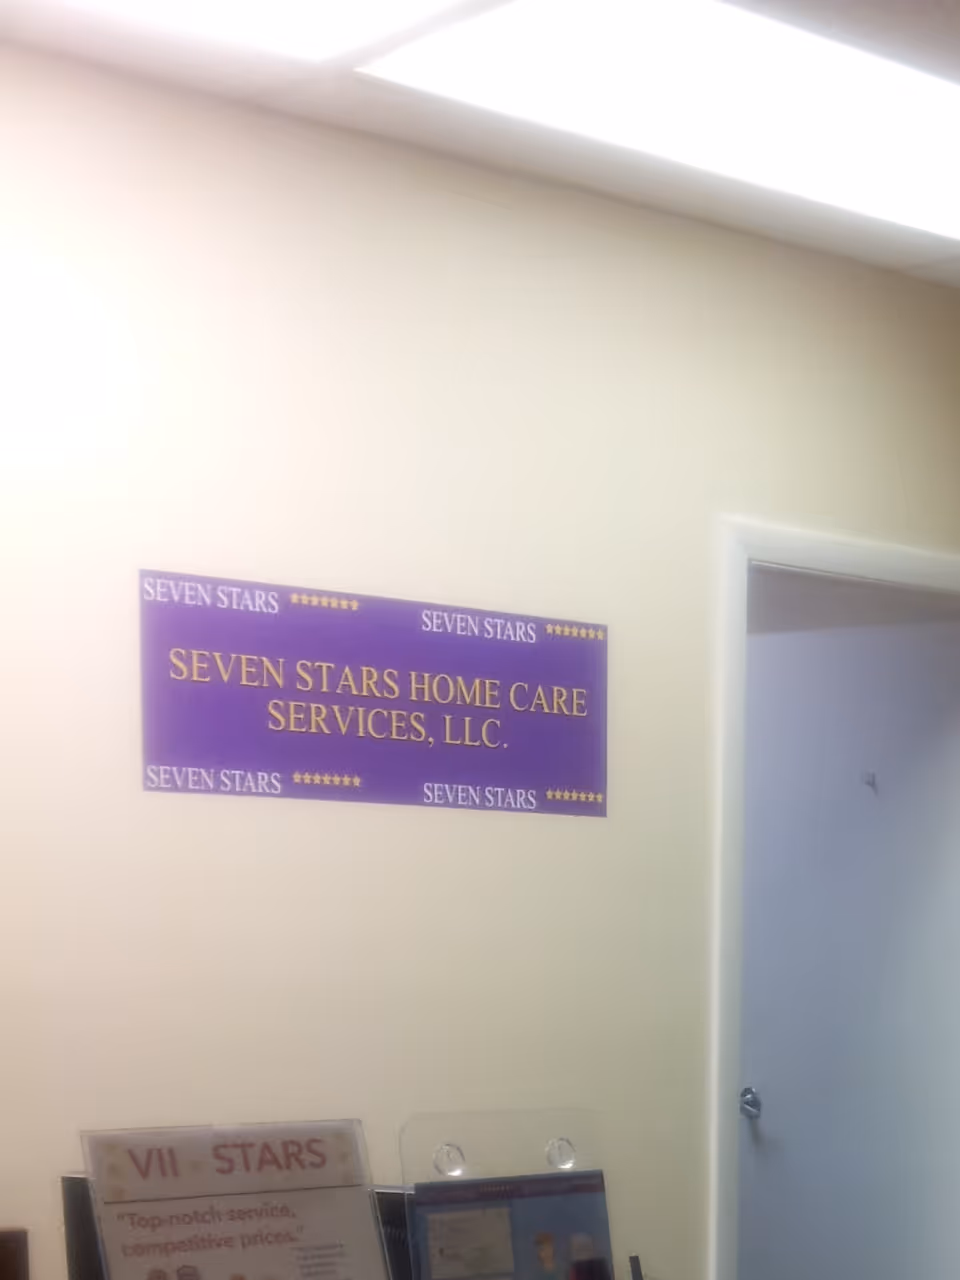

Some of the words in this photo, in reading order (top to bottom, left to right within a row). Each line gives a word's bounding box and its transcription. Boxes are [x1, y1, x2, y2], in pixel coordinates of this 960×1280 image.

[143, 576, 212, 606] SEVEN
[216, 585, 279, 614] STARS
[421, 609, 480, 637] SEVEN
[483, 617, 537, 644] STARS
[168, 647, 286, 688] SEVEN
[295, 660, 401, 699] STARS
[408, 670, 502, 710] HOME
[508, 681, 588, 718] CARE
[266, 699, 436, 749] SERVICES,
[443, 714, 509, 750] LLC.
[145, 764, 215, 792] SEVEN
[219, 768, 282, 795] STARS
[422, 781, 481, 806] SEVEN
[483, 785, 537, 811] STARS
[127, 1146, 180, 1181] VII
[211, 1137, 329, 1176] STARS
[120, 1234, 234, 1258] competitive
